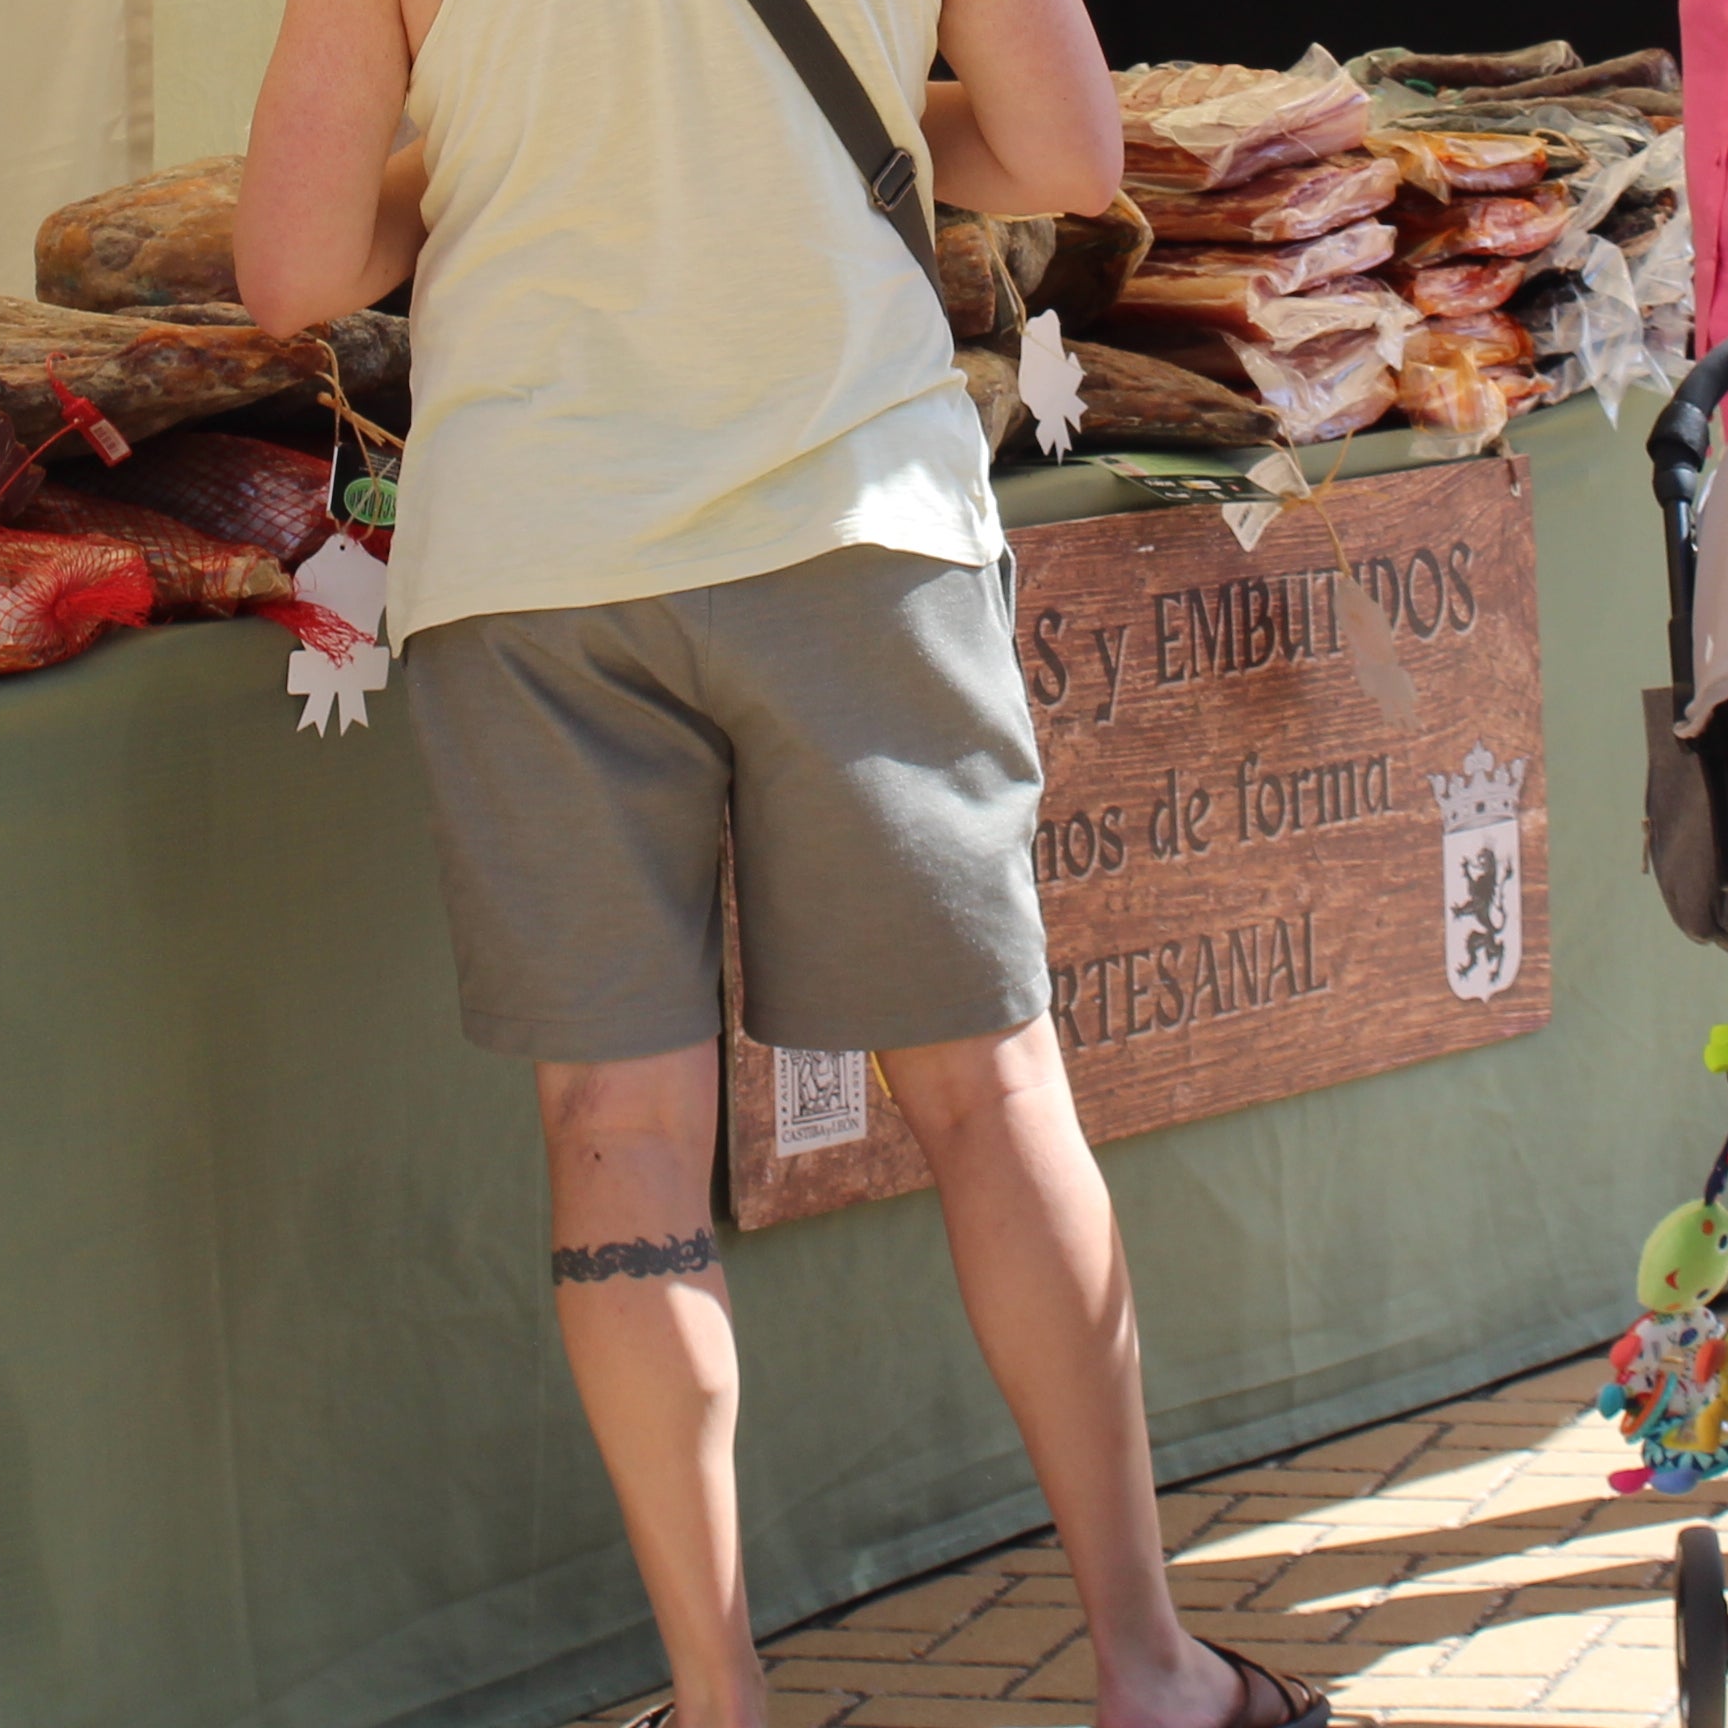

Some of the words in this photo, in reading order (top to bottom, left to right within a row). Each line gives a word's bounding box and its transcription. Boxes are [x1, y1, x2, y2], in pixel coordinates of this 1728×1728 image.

[1017, 606, 1069, 708] S
[1090, 624, 1129, 727] y
[1152, 540, 1476, 686] EMBUTDOS
[1149, 767, 1212, 860] de
[1233, 751, 1394, 844] forma
[1050, 910, 1329, 1050] RTESANAL
